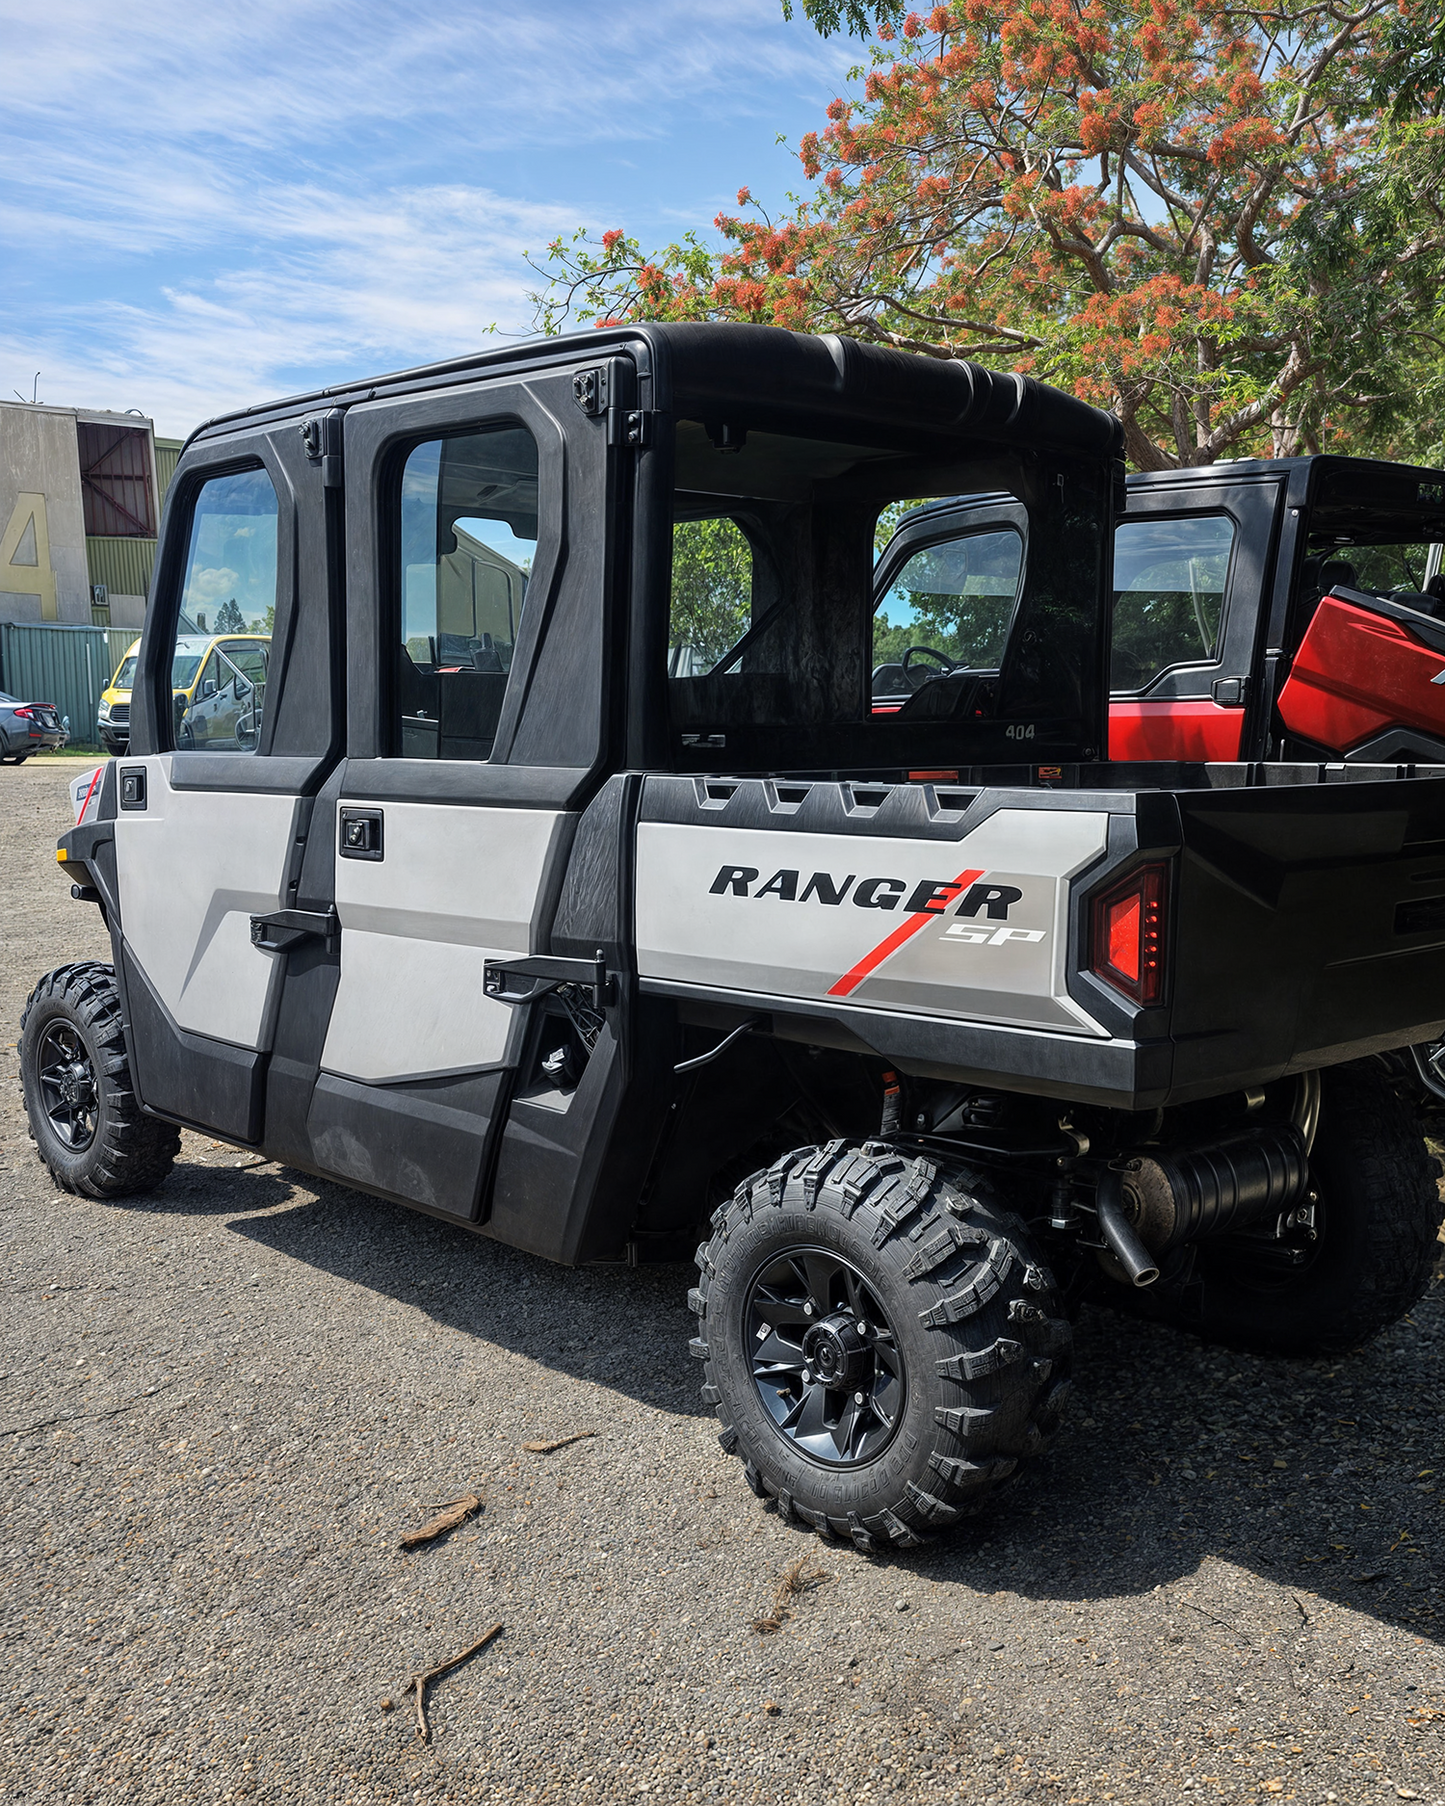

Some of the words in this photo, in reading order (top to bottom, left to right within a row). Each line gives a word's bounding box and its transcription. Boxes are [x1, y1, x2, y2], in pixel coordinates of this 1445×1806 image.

[1005, 724, 1035, 740] 404
[708, 865, 1023, 920] RANGER
[938, 923, 1046, 945] SP
